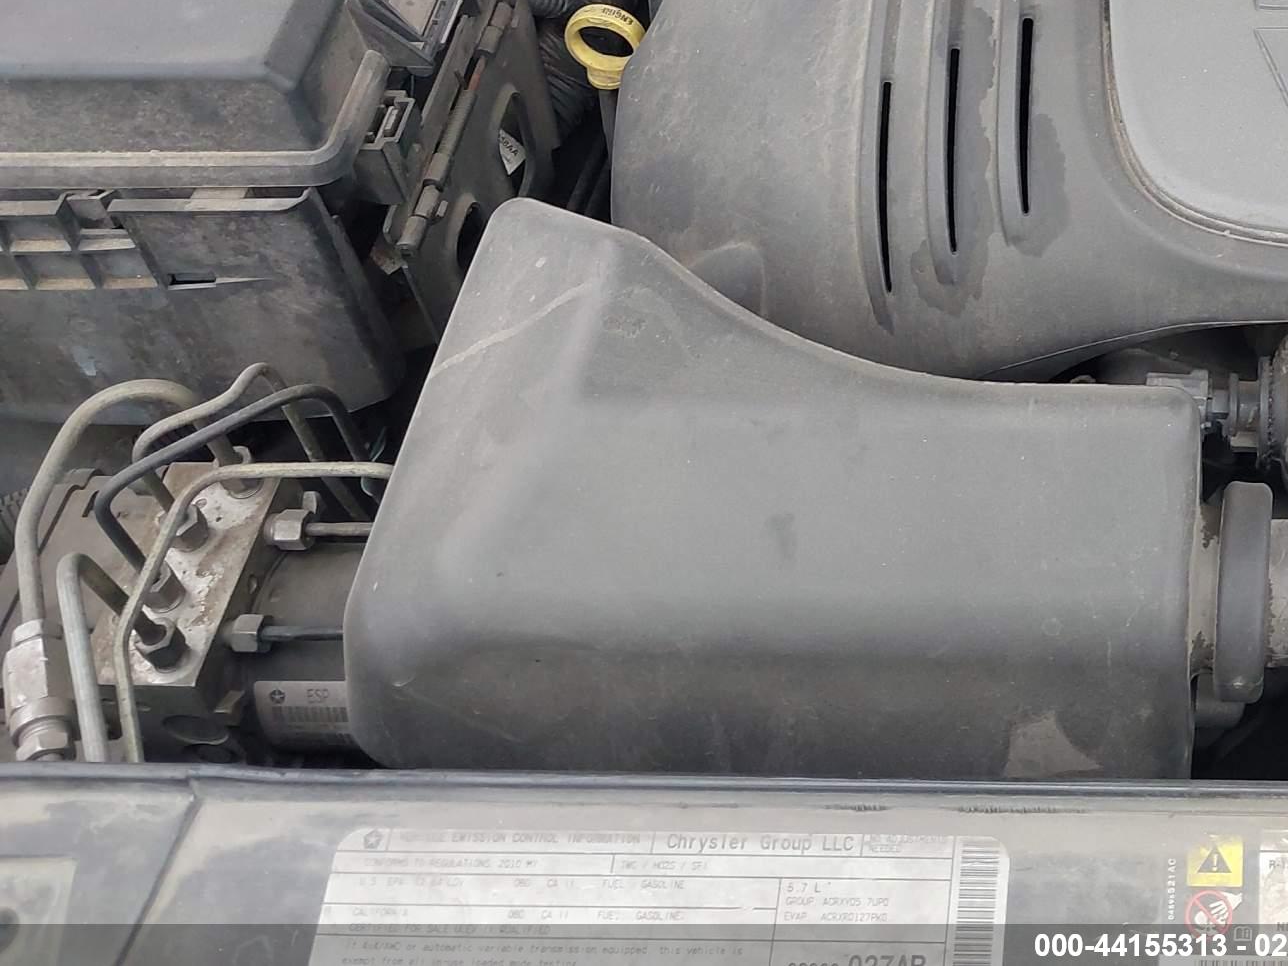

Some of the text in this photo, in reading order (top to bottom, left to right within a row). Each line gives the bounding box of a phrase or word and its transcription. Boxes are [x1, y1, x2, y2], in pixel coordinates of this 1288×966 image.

[451, 832, 507, 843] EMISSION
[512, 833, 558, 843] CONTROL
[567, 833, 641, 844] INFORMATION
[667, 833, 749, 853] Chrysler
[760, 835, 812, 854] Group
[822, 835, 855, 852] LLC
[786, 882, 822, 893] 5.7 L
[423, 943, 473, 952] automatic
[479, 945, 524, 953] variable
[530, 945, 598, 954] transmission
[687, 947, 726, 956] vehicle
